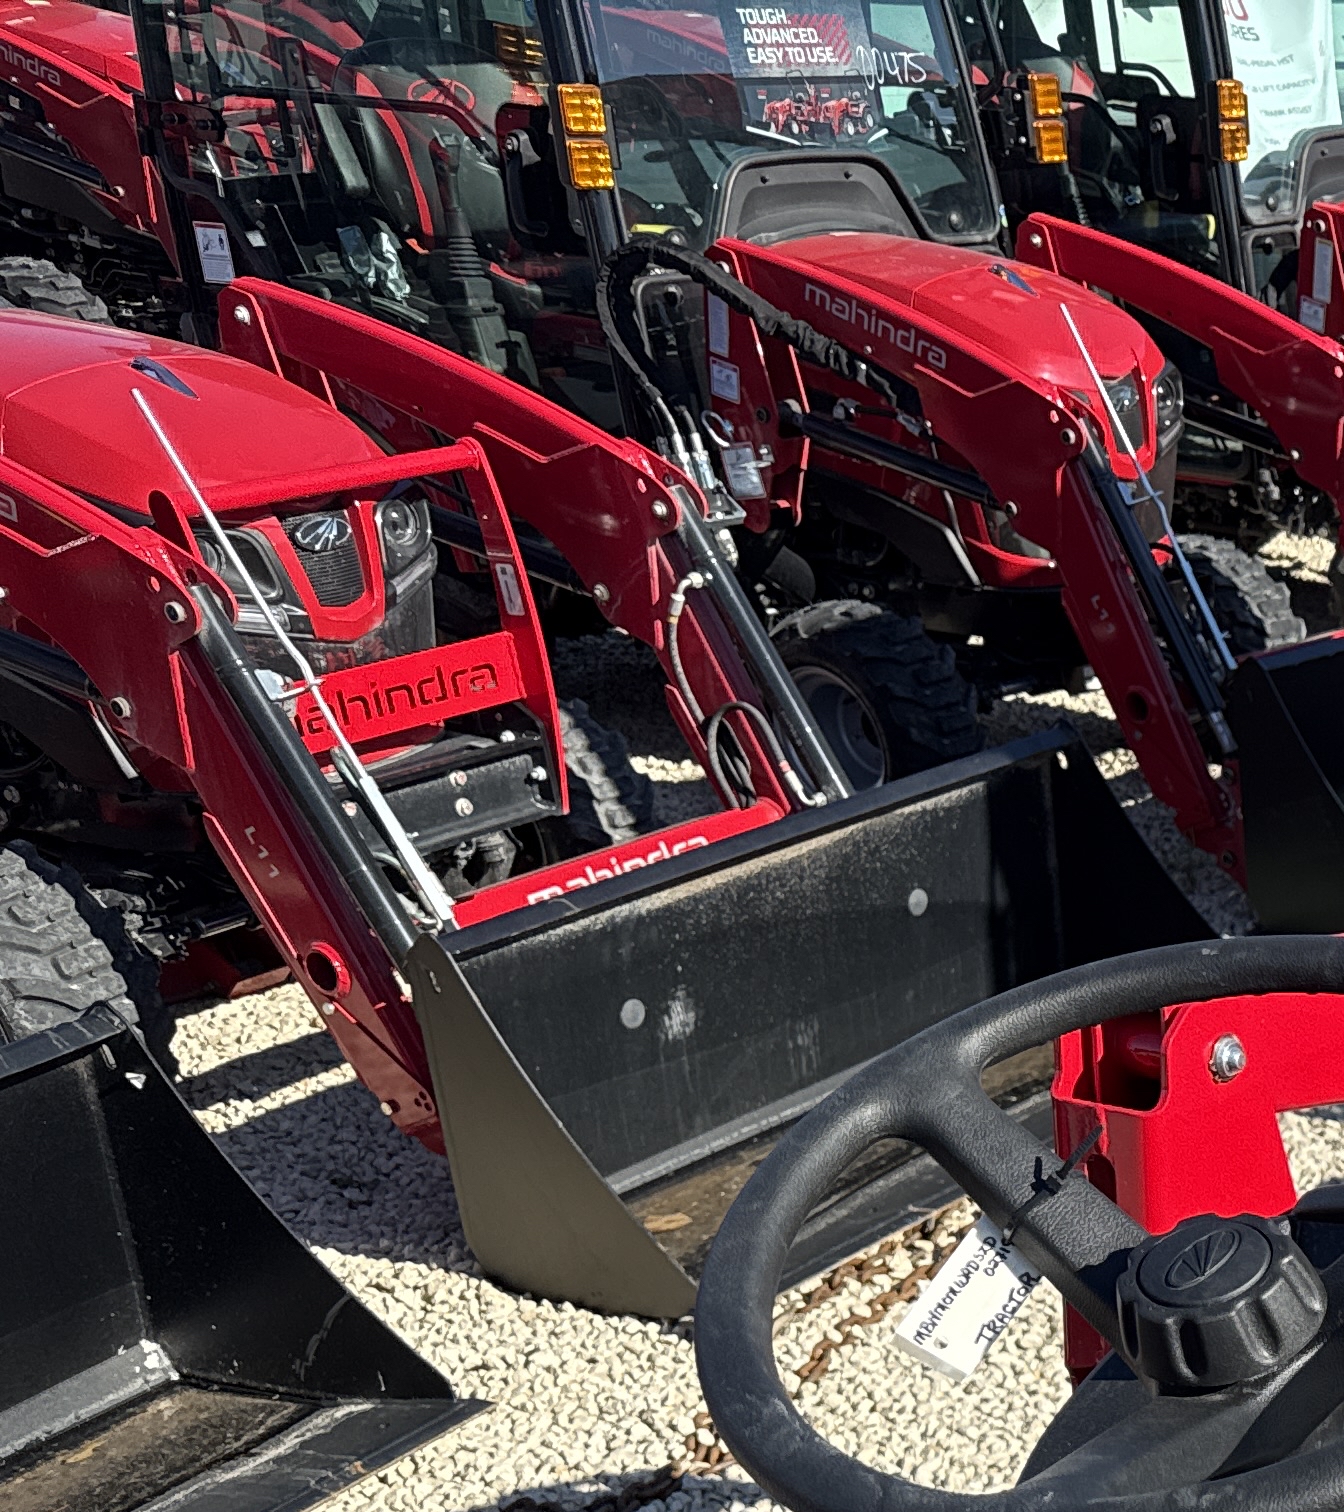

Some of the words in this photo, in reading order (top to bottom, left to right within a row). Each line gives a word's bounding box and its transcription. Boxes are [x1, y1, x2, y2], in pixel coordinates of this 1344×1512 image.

[736, 8, 791, 25] TOUGH.
[743, 27, 823, 44] ADVANCED.
[746, 47, 783, 64] EASY
[783, 46, 805, 63] TO
[807, 46, 839, 63] USE.
[805, 282, 947, 370] mahindra
[294, 662, 499, 738] ahindra
[974, 1271, 1043, 1344] TRACTOR
